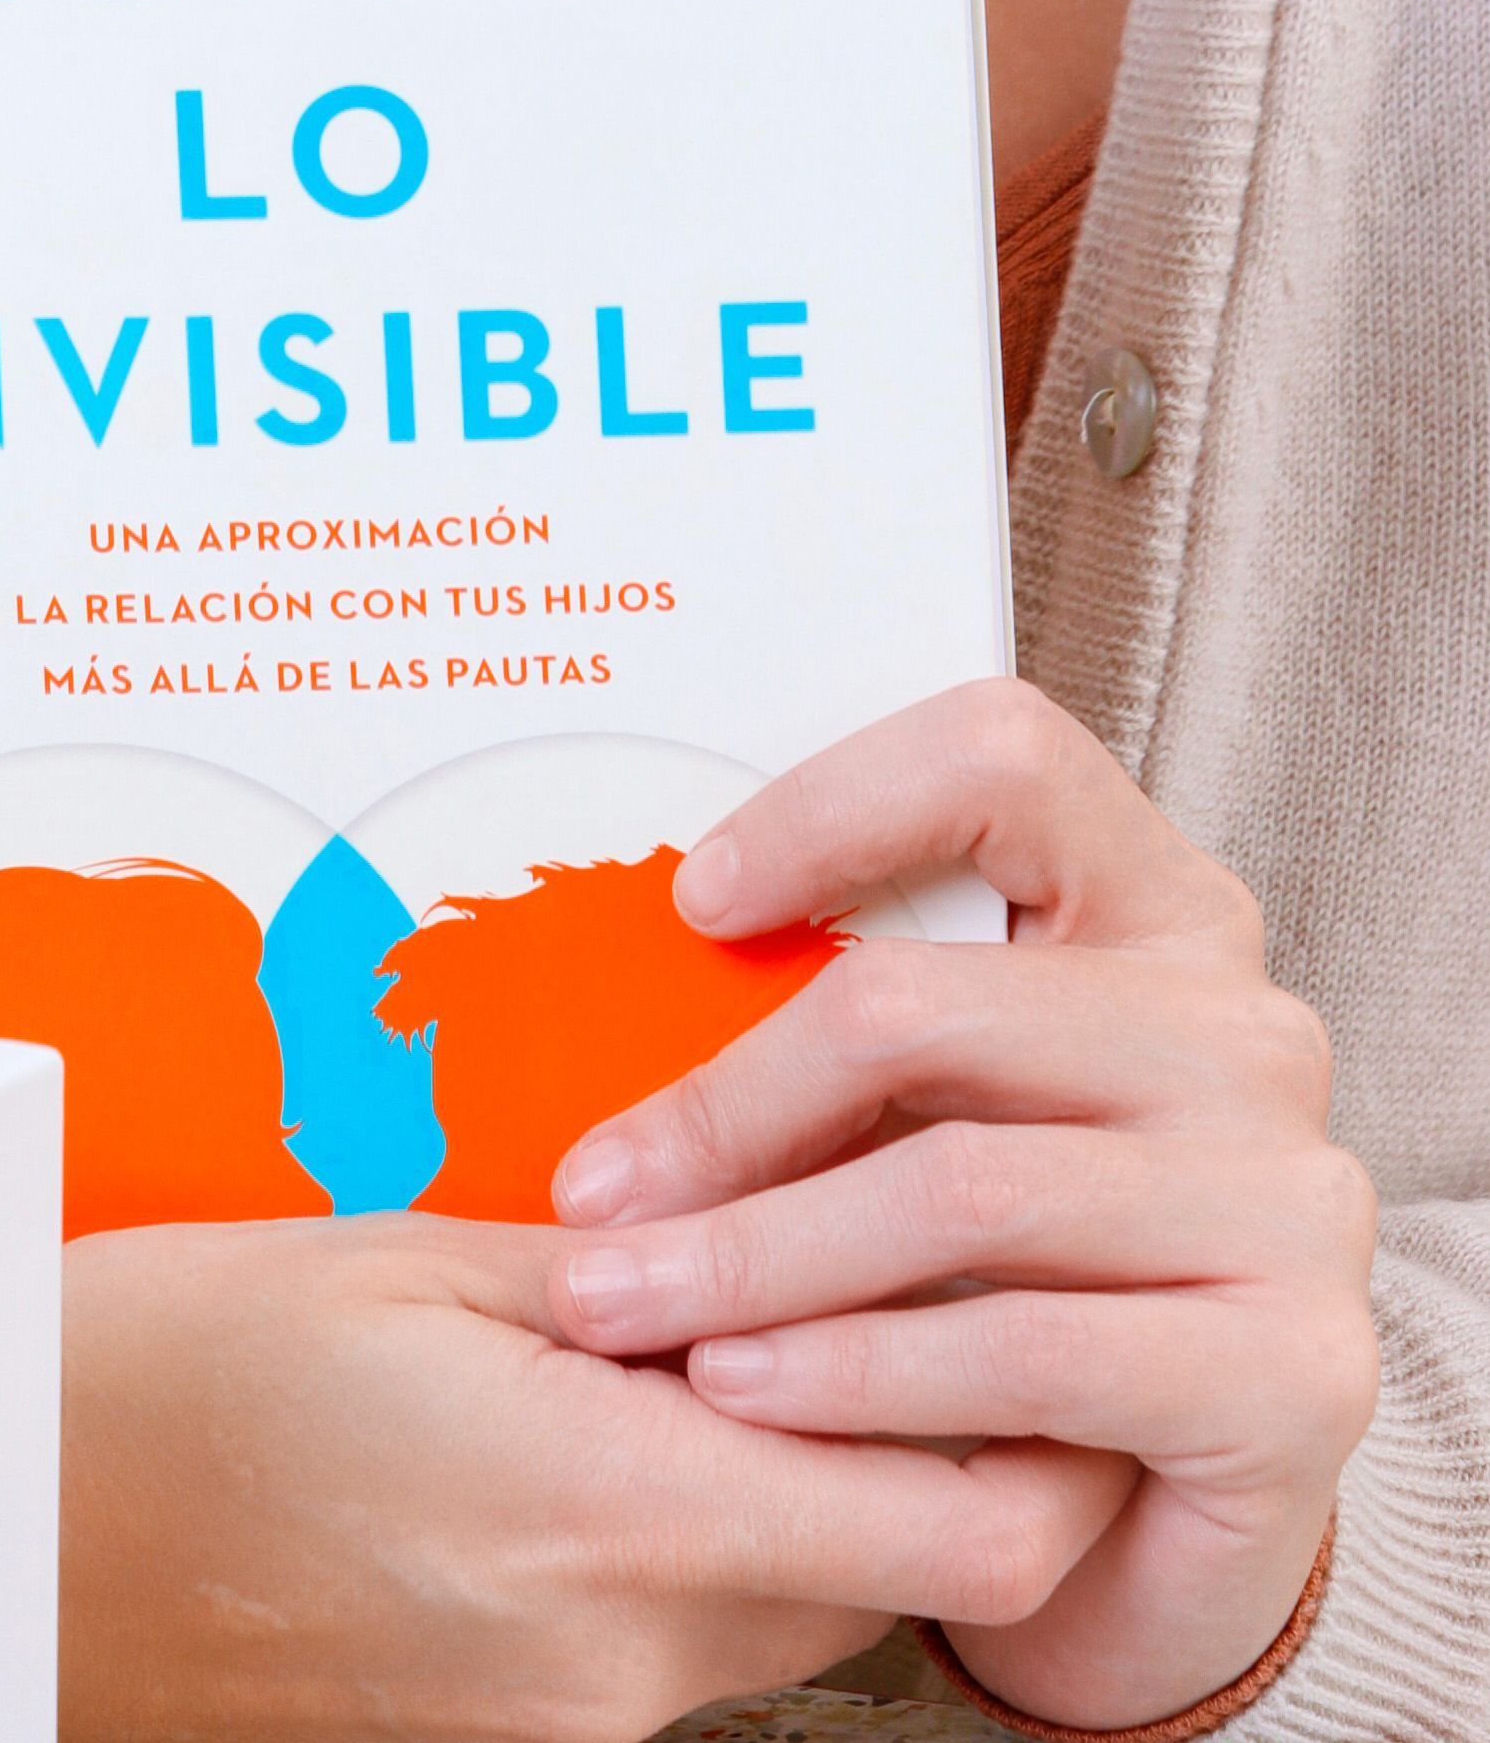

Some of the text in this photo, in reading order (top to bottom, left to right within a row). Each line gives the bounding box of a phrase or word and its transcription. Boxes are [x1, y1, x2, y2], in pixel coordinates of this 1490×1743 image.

[175, 84, 429, 221] LO
[90, 506, 549, 553] UNA APROXIMACIÓN
[16, 596, 67, 624] LA
[86, 582, 311, 623] RELACIÓN
[331, 589, 427, 619] CON
[446, 586, 526, 616] TUS
[545, 581, 675, 614] HIJOS
[44, 652, 611, 694] MÁS ALLÁ DE LAS PAUTAS
